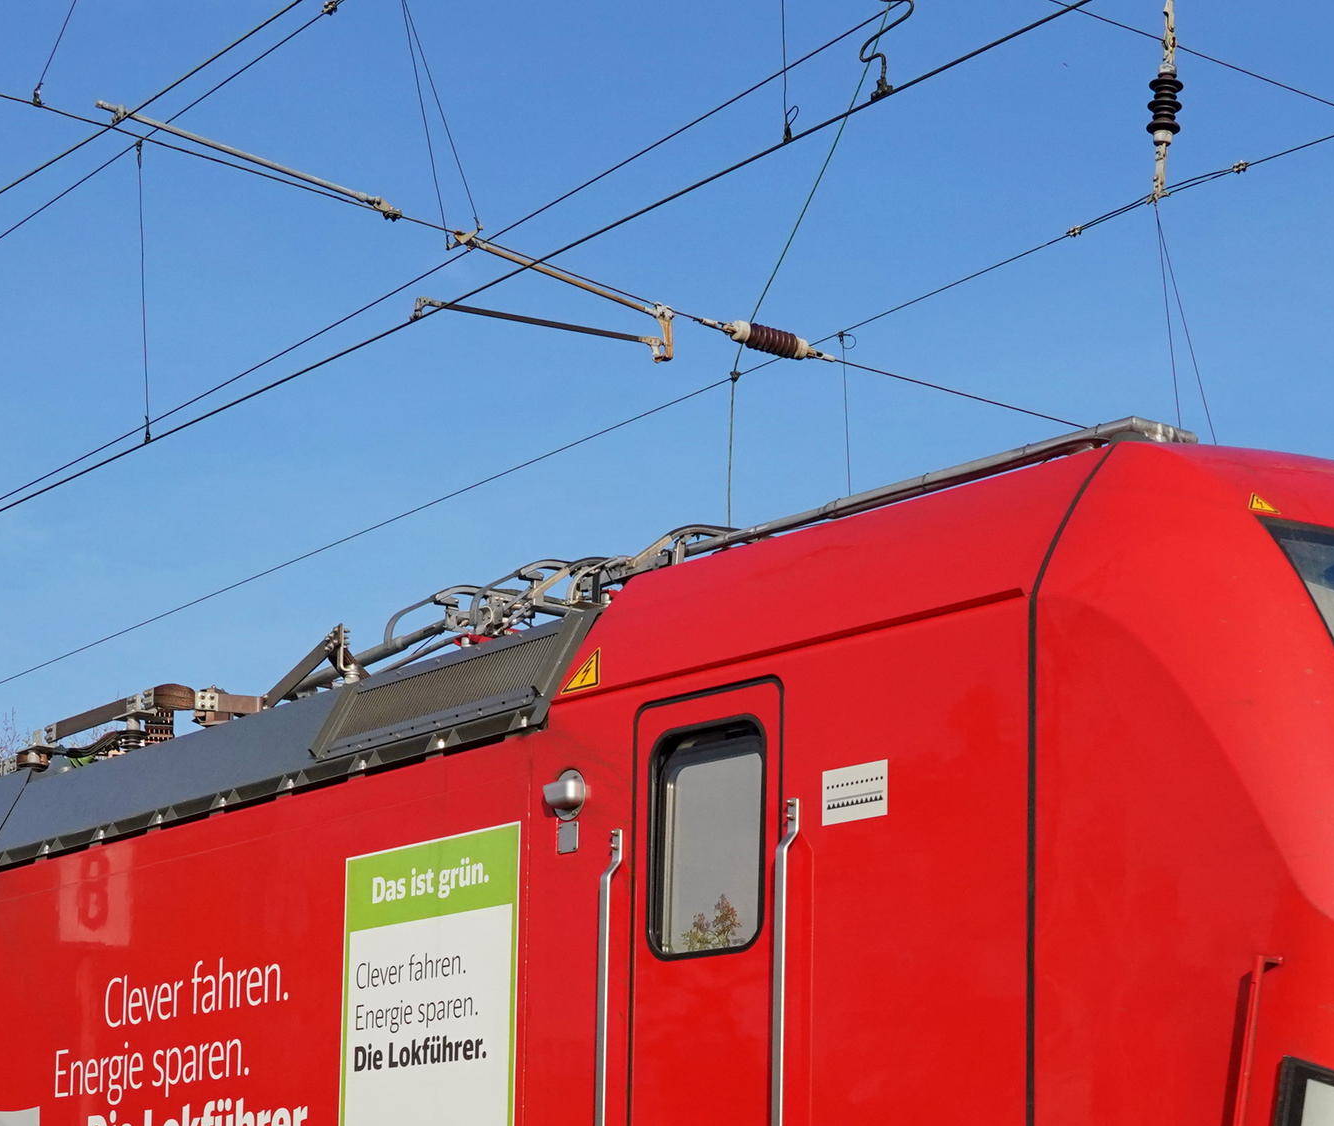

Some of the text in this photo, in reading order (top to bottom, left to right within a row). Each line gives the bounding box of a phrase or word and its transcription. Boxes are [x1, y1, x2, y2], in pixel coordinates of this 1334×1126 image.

[371, 857, 490, 904] Das ist grün.
[356, 953, 466, 989] Clever fahren.
[104, 957, 289, 1028] Clever fahren.
[355, 996, 479, 1034] Energie sparen.
[54, 1038, 250, 1105] Energie sparen.
[354, 1035, 487, 1072] Die Lokführer.
